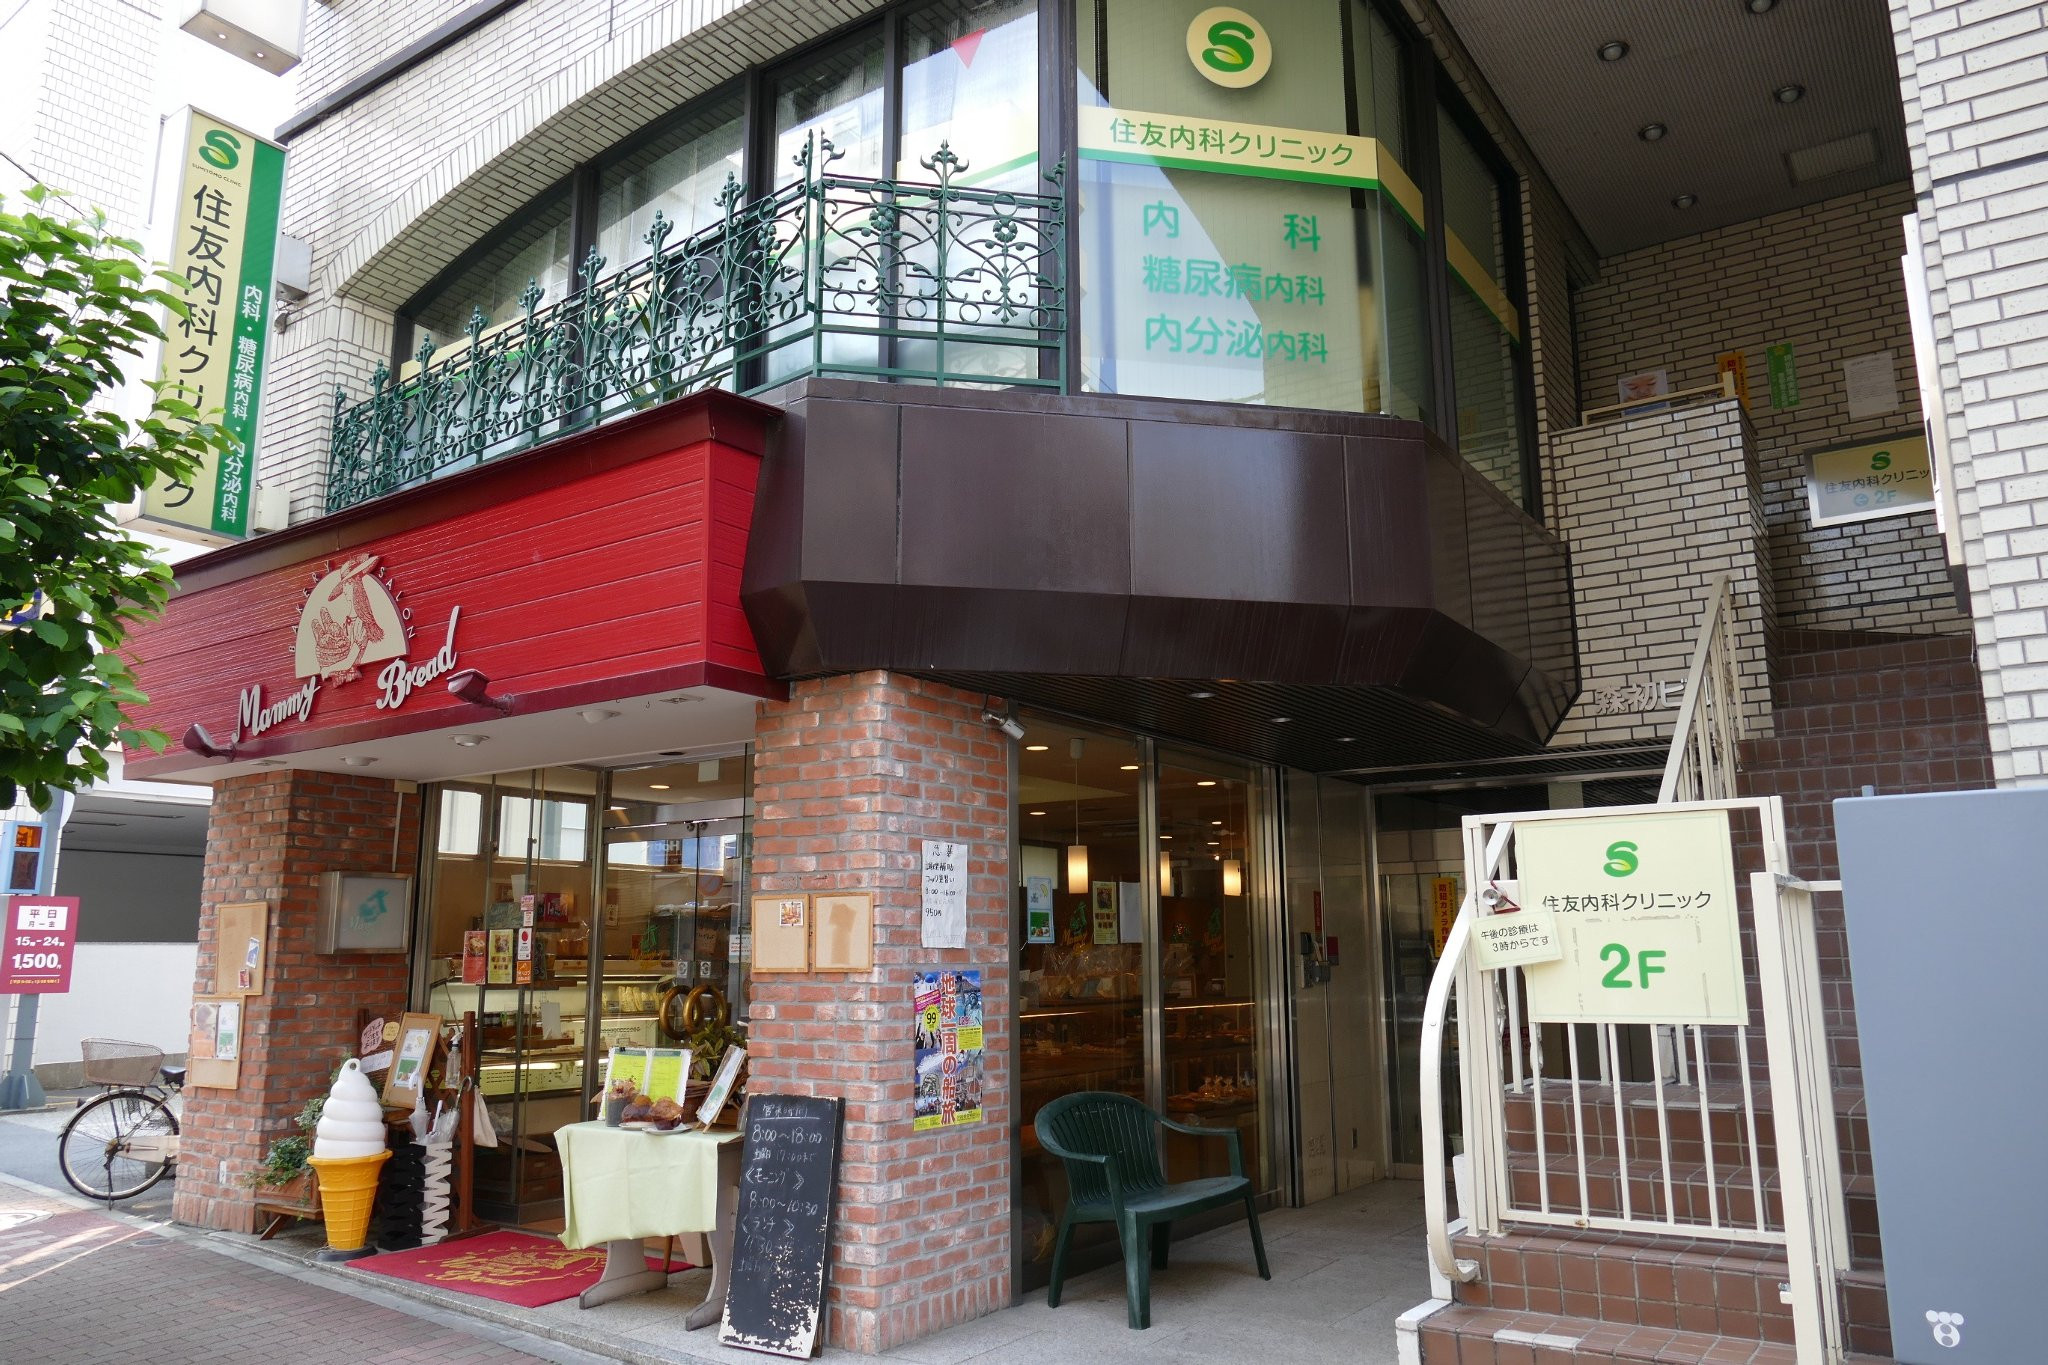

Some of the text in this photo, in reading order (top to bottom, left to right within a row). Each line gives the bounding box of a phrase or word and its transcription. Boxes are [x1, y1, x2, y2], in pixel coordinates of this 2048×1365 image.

[1110, 118, 1353, 167] 住友内科クリニック
[192, 163, 242, 187] SUMITOMO CLINIC
[1142, 255, 1326, 306] 糖尿病内科
[163, 184, 232, 508] 住友内科クリク
[1145, 312, 1329, 365] 内分泌内科
[1874, 489, 1897, 505] 2F
[231, 605, 462, 743] Mammy Bread
[1595, 677, 1712, 714] 森初ビ
[29, 909, 57, 919] 平日
[1542, 890, 1712, 914] 住友内科クリニック
[1481, 923, 1539, 940] 午後の診療は
[1492, 935, 1550, 952] 3時からです
[1600, 942, 1667, 989] 2F
[926, 1012, 937, 1025] 99
[941, 971, 957, 1126] 地球一周の船旅
